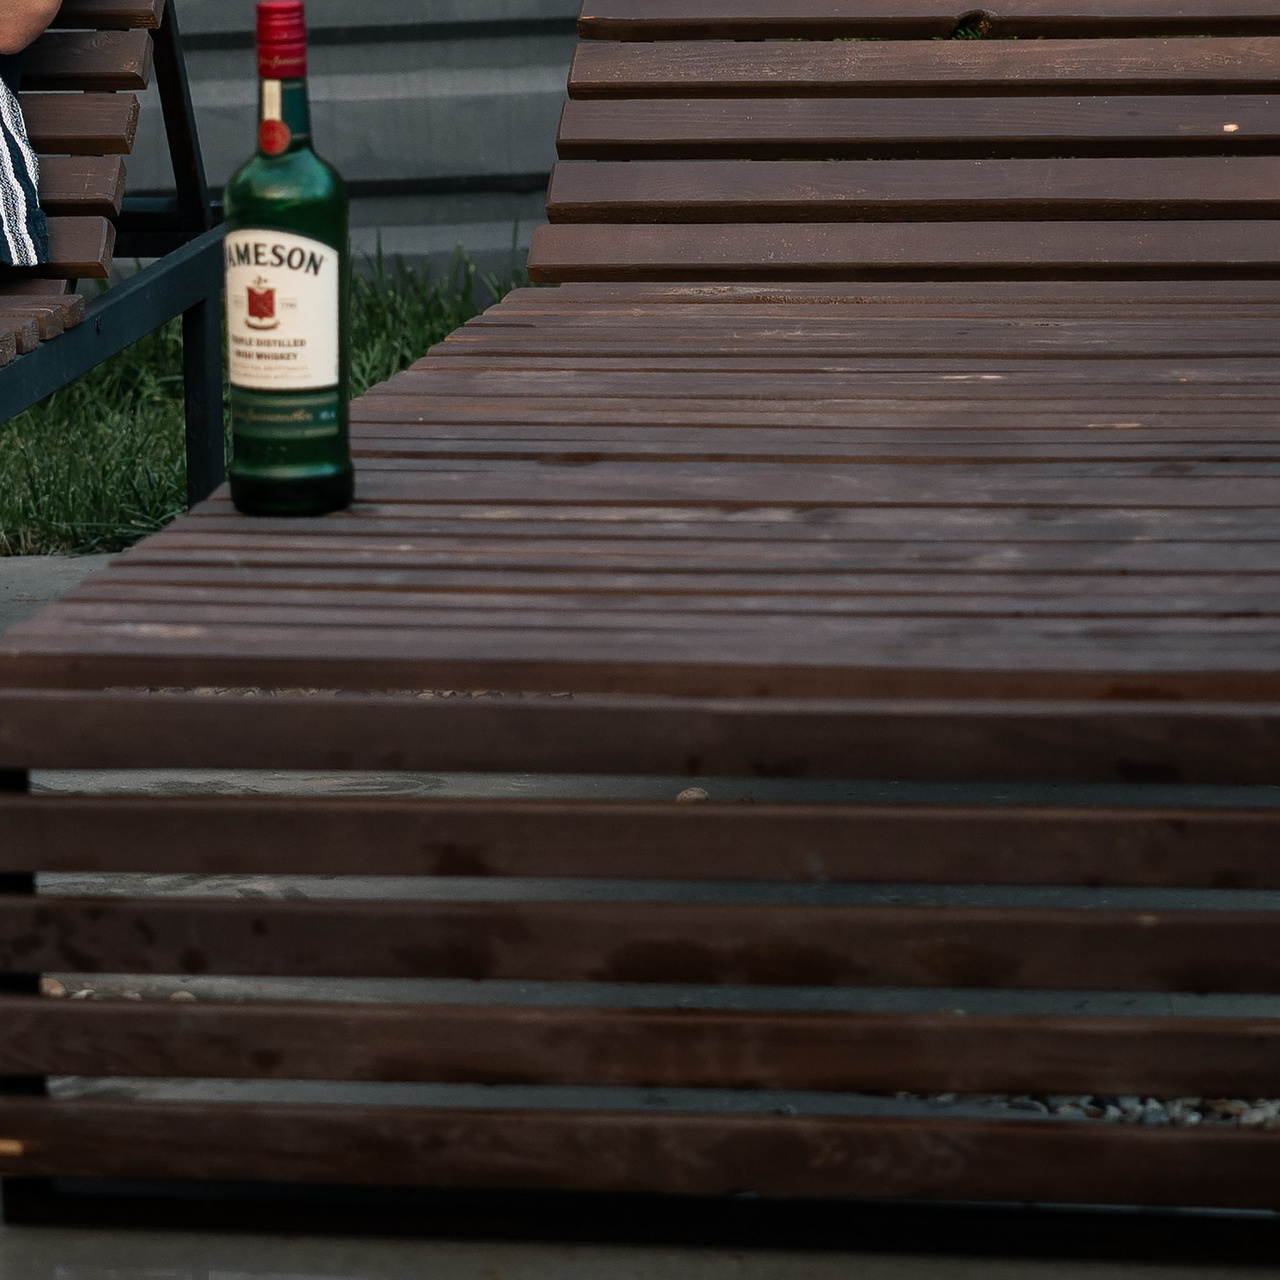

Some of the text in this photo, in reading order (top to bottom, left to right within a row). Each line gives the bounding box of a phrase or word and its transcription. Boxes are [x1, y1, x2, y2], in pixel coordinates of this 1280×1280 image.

[226, 242, 324, 276] AMESON
[256, 338, 307, 348] DISTILLED
[255, 351, 298, 361] WHISKEY
